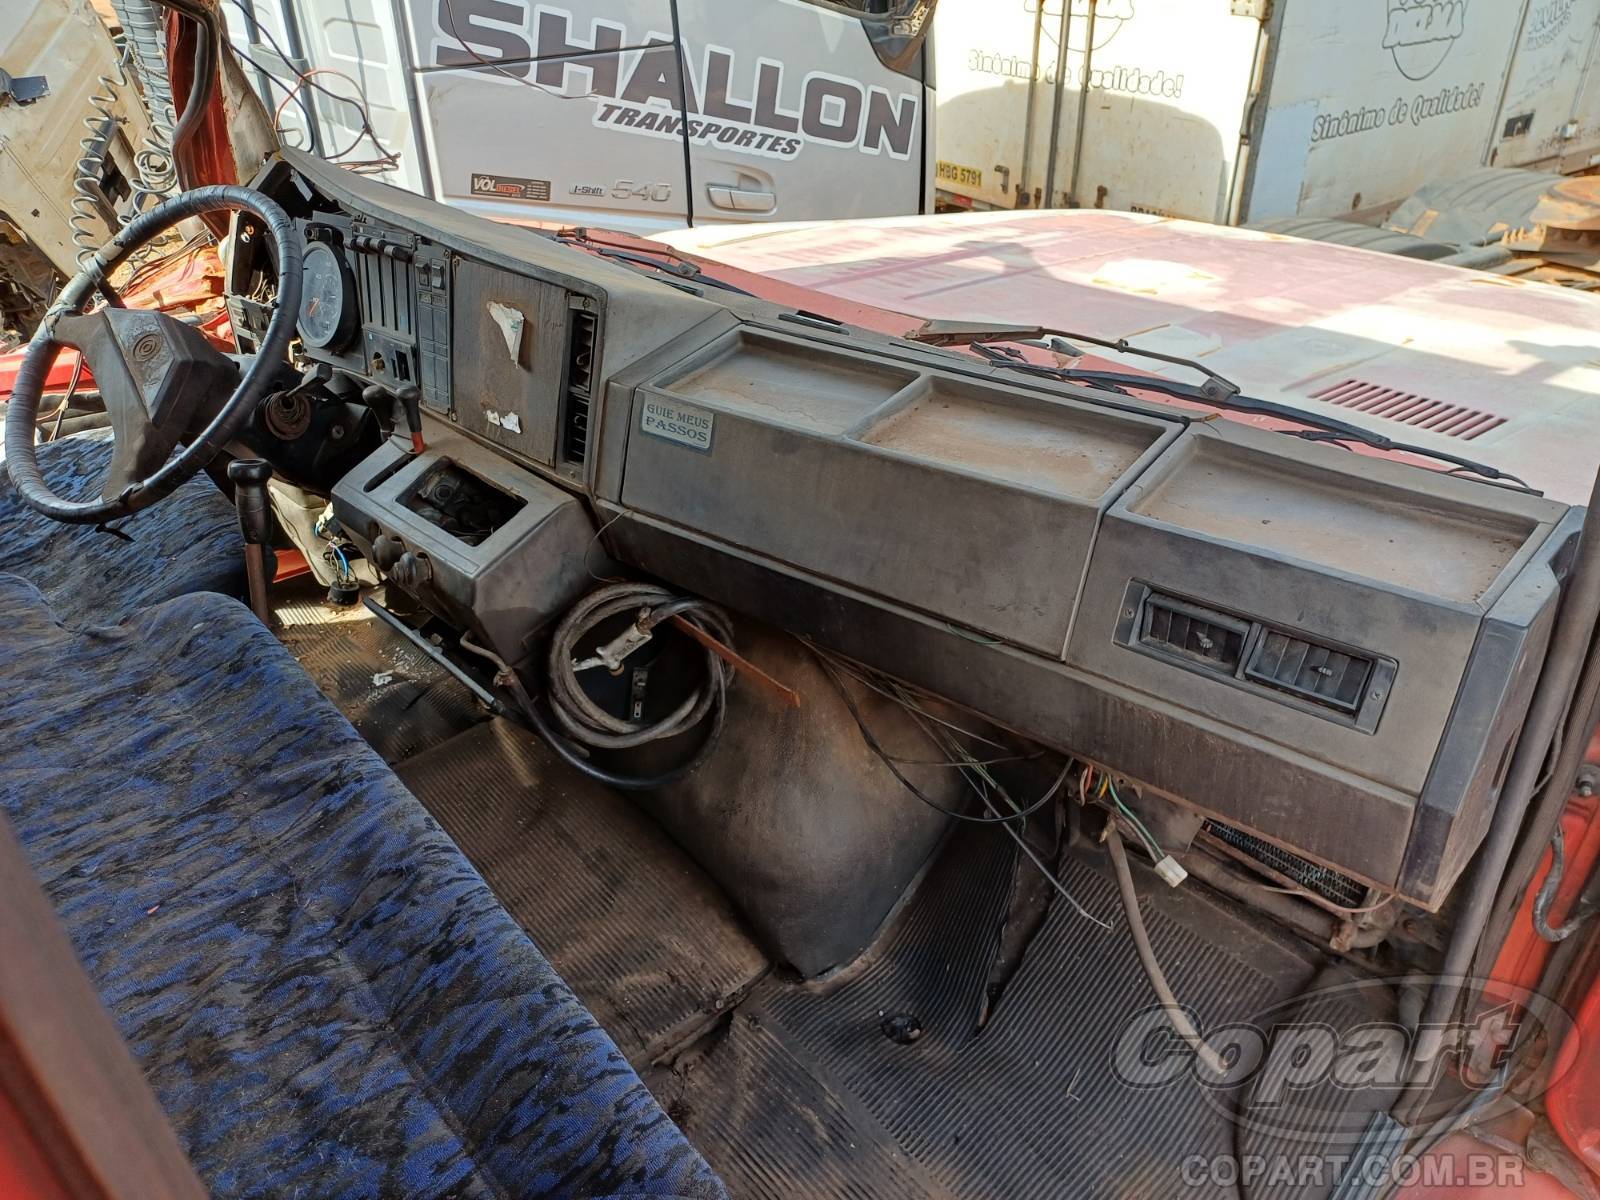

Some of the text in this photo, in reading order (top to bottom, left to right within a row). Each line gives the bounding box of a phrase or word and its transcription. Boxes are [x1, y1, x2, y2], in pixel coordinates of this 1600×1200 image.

[434, 0, 917, 157] SHALLON
[598, 103, 801, 155] TRANSPORTES
[1311, 106, 1386, 142] Sinônimo
[1388, 97, 1408, 126] de
[960, 167, 982, 187] 5791
[611, 180, 671, 202] 540
[646, 416, 708, 442] PASSOS
[647, 404, 709, 429] GUIE MEUS
